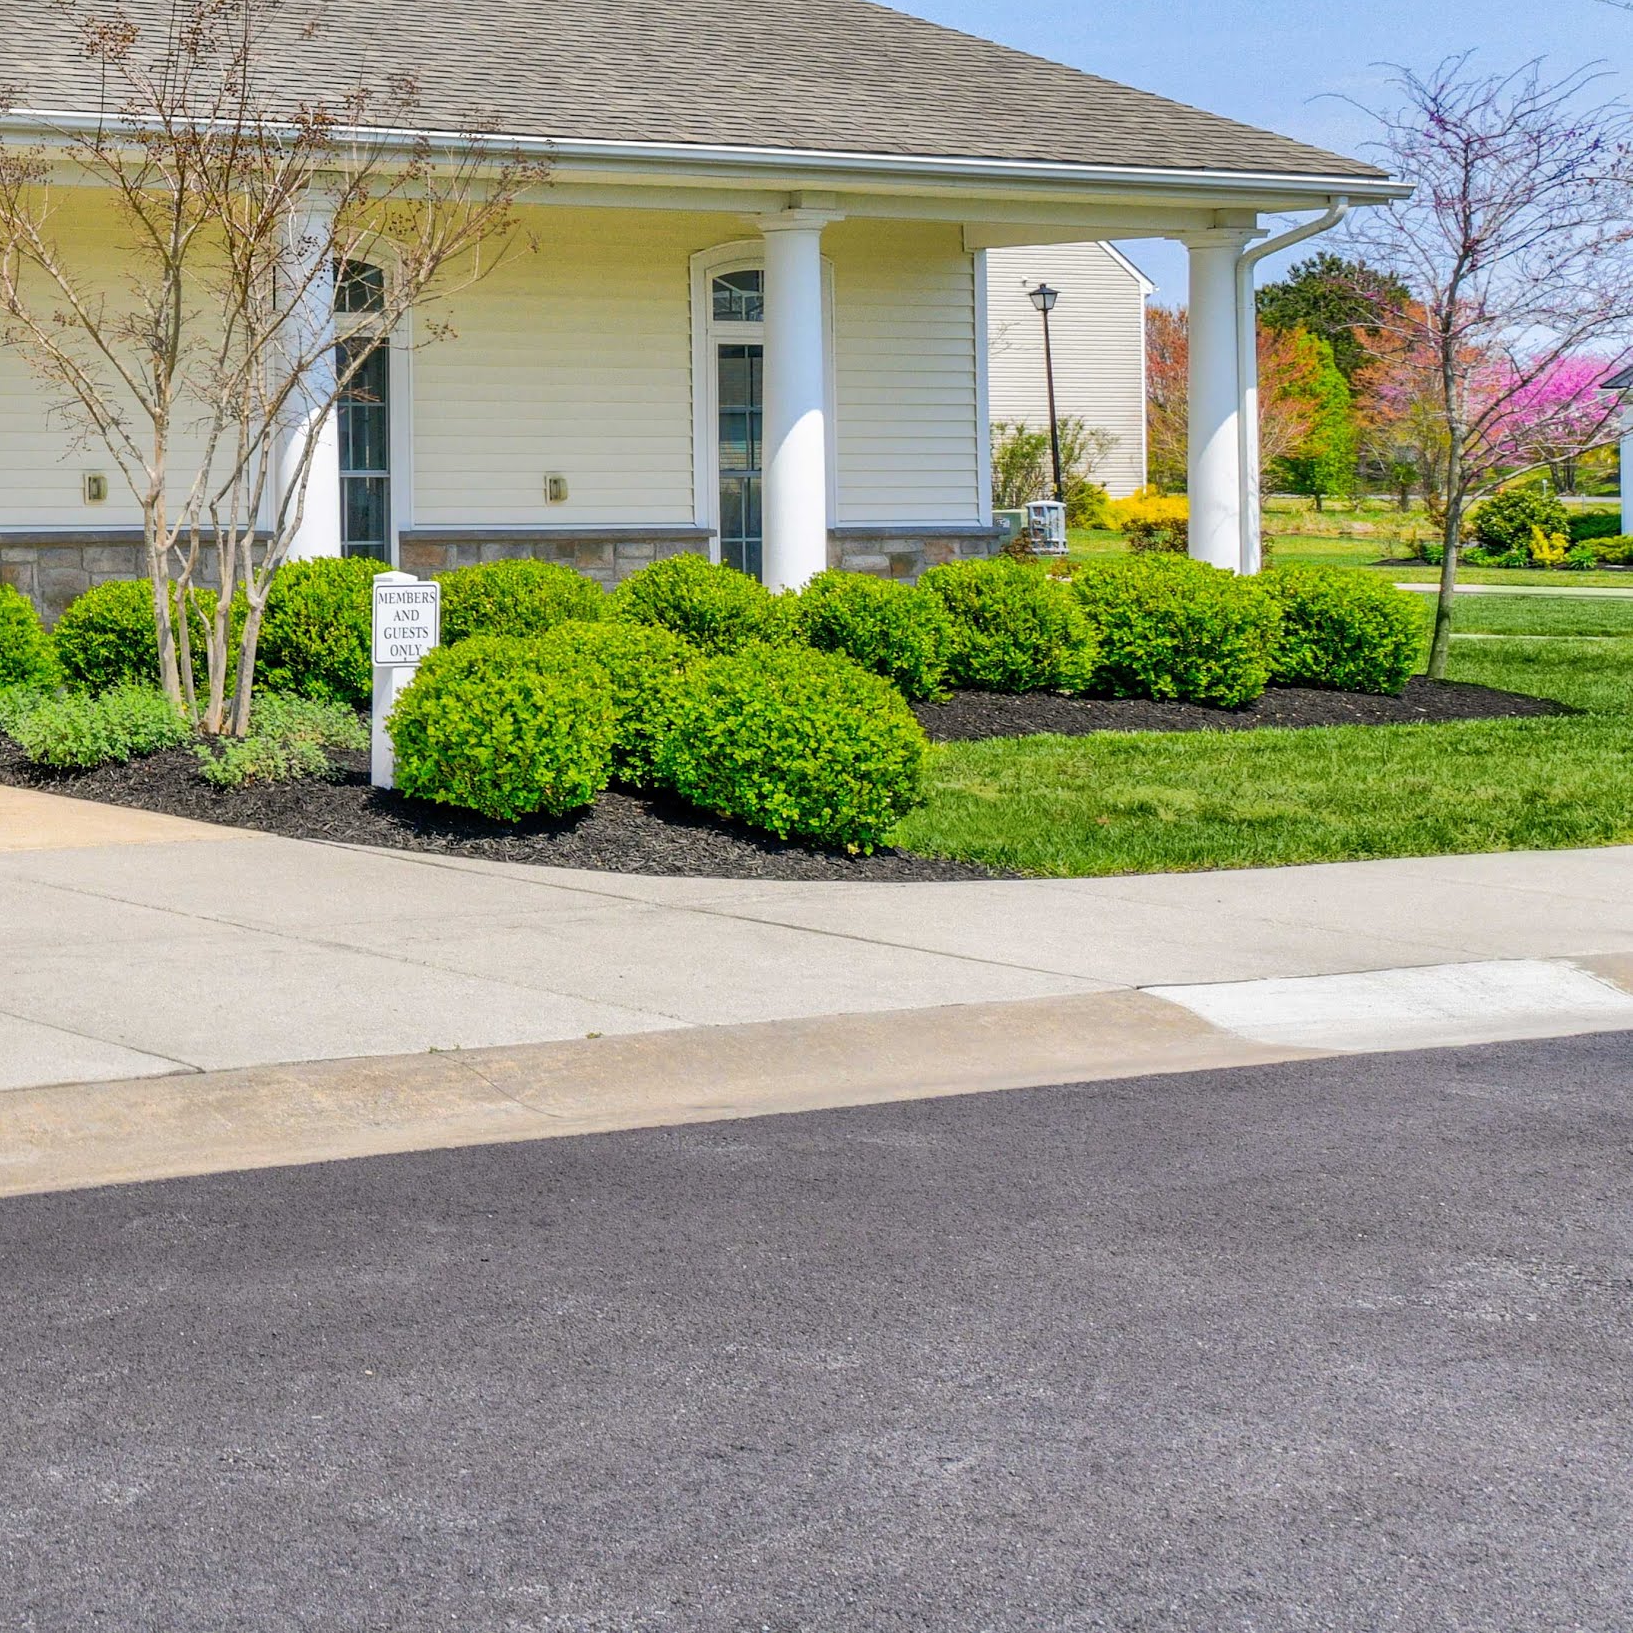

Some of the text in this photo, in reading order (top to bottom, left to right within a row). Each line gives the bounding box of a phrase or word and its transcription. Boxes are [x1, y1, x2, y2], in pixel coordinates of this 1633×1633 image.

[378, 591, 436, 604] MEMBERS
[393, 609, 420, 622] AND
[383, 626, 429, 640] GUESTS
[390, 643, 422, 657] ONLY
